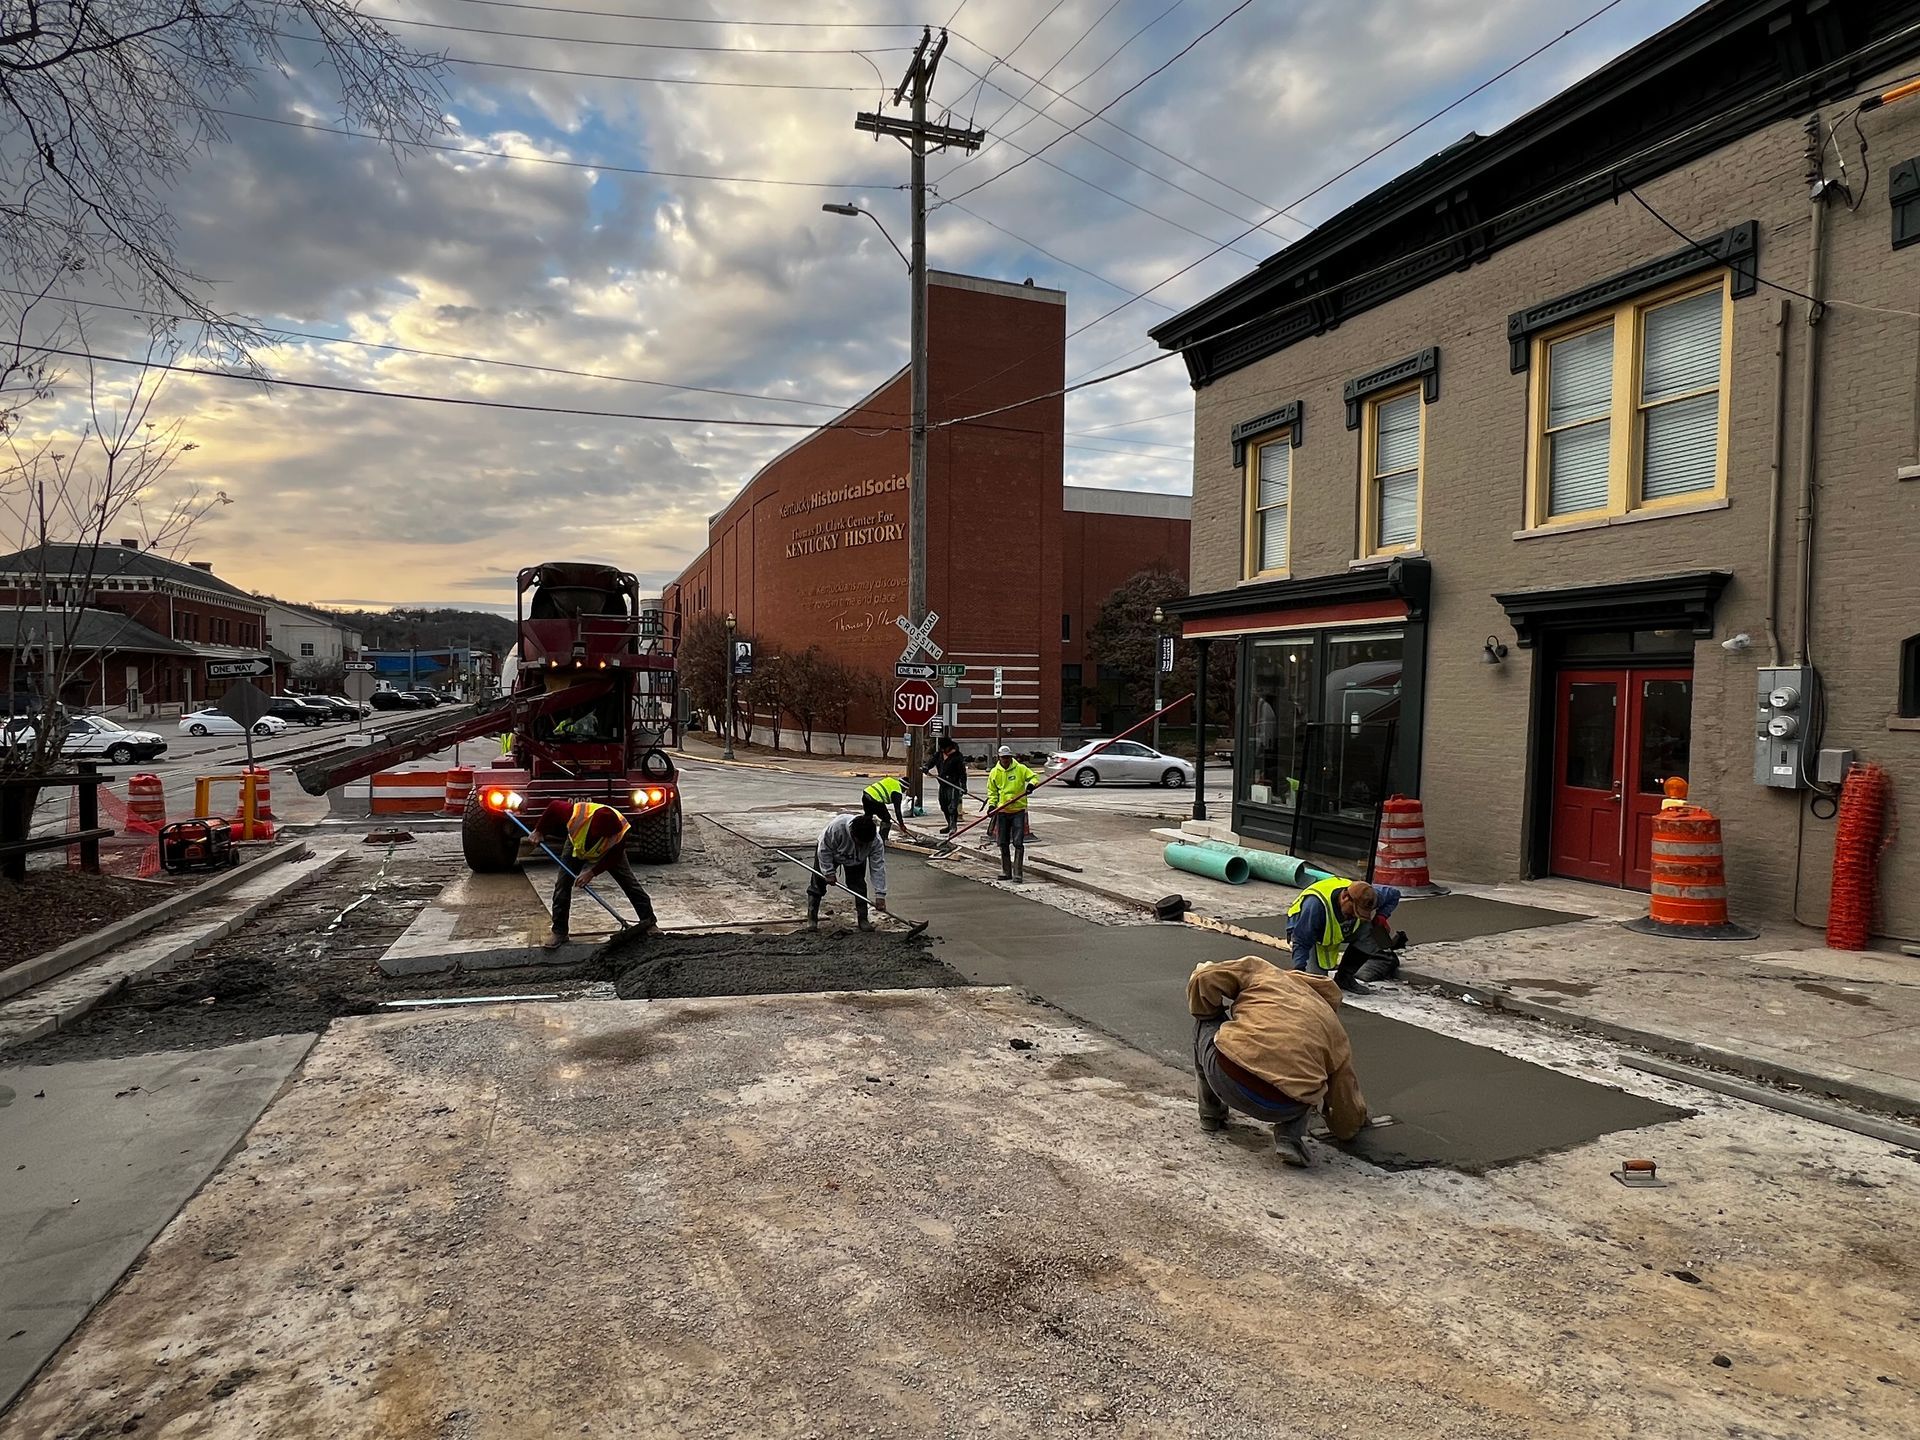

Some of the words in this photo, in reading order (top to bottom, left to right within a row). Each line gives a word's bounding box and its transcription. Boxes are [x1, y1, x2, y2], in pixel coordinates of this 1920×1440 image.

[825, 517, 845, 532] Clark
[847, 514, 875, 528] Center
[877, 510, 894, 523] For
[785, 533, 839, 559] KENTUCKY
[844, 522, 906, 547] HISTORY
[898, 618, 941, 659] CROSSING
[213, 666, 231, 674] ONE
[234, 664, 253, 672] WAY
[899, 667, 911, 675] ONE
[912, 667, 925, 675] WAY
[940, 666, 956, 675] HIGH
[897, 693, 935, 712] STOP
